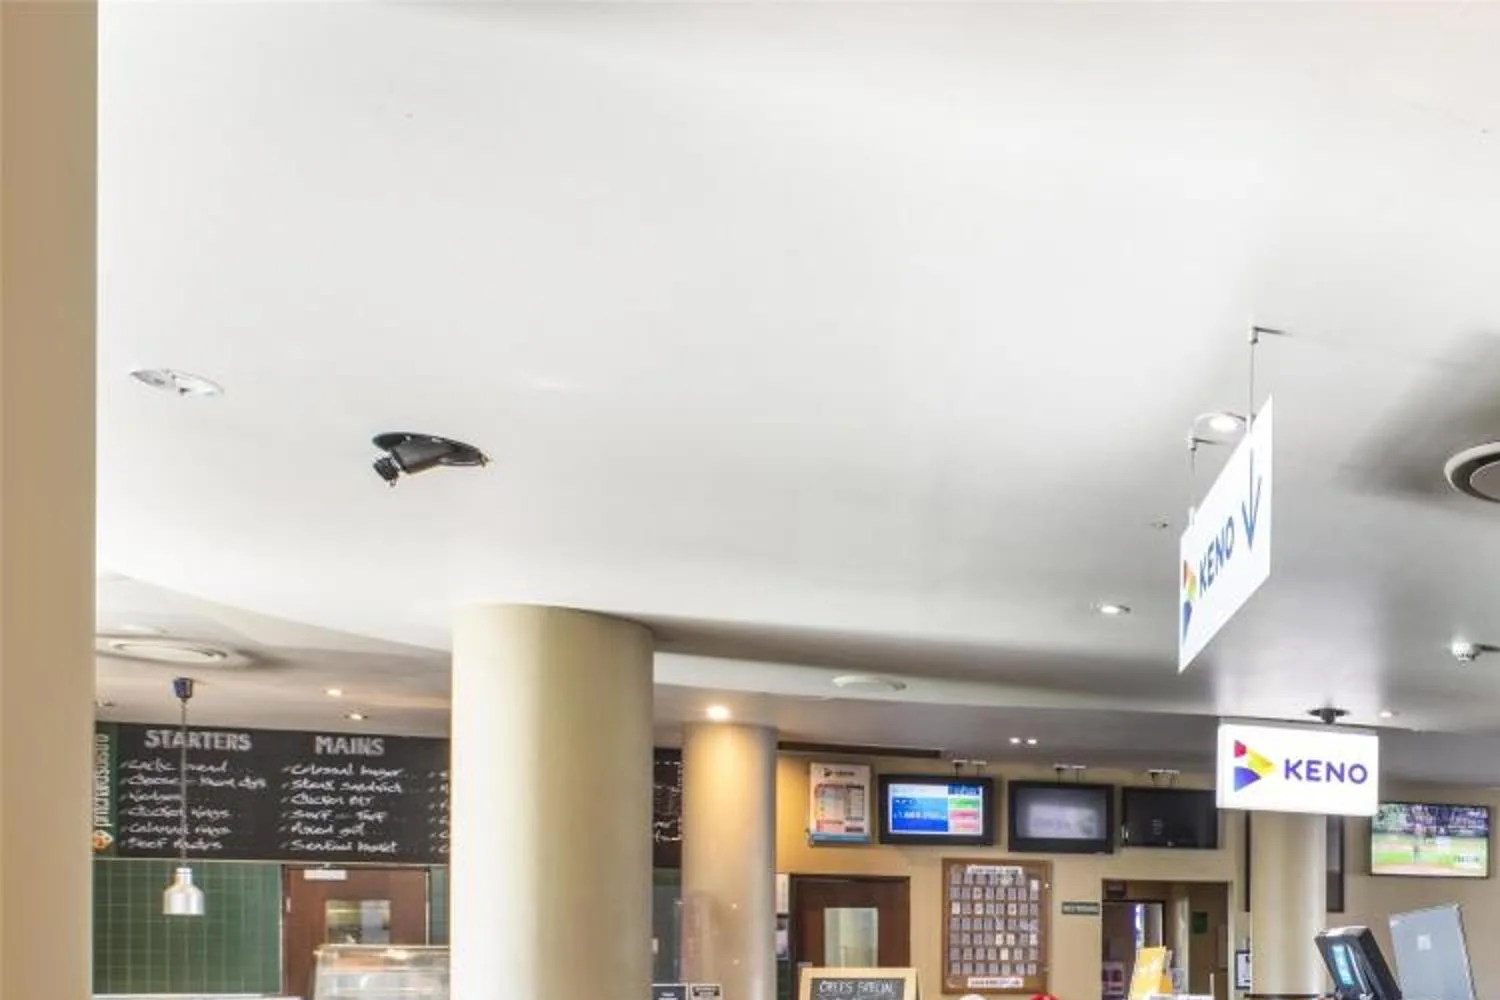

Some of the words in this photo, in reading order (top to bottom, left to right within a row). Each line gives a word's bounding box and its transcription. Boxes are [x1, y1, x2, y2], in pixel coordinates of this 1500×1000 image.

[1199, 515, 1235, 596] KENO
[144, 729, 252, 750] STARTERS
[315, 735, 386, 756] MAINS
[1284, 758, 1368, 785] KENO
